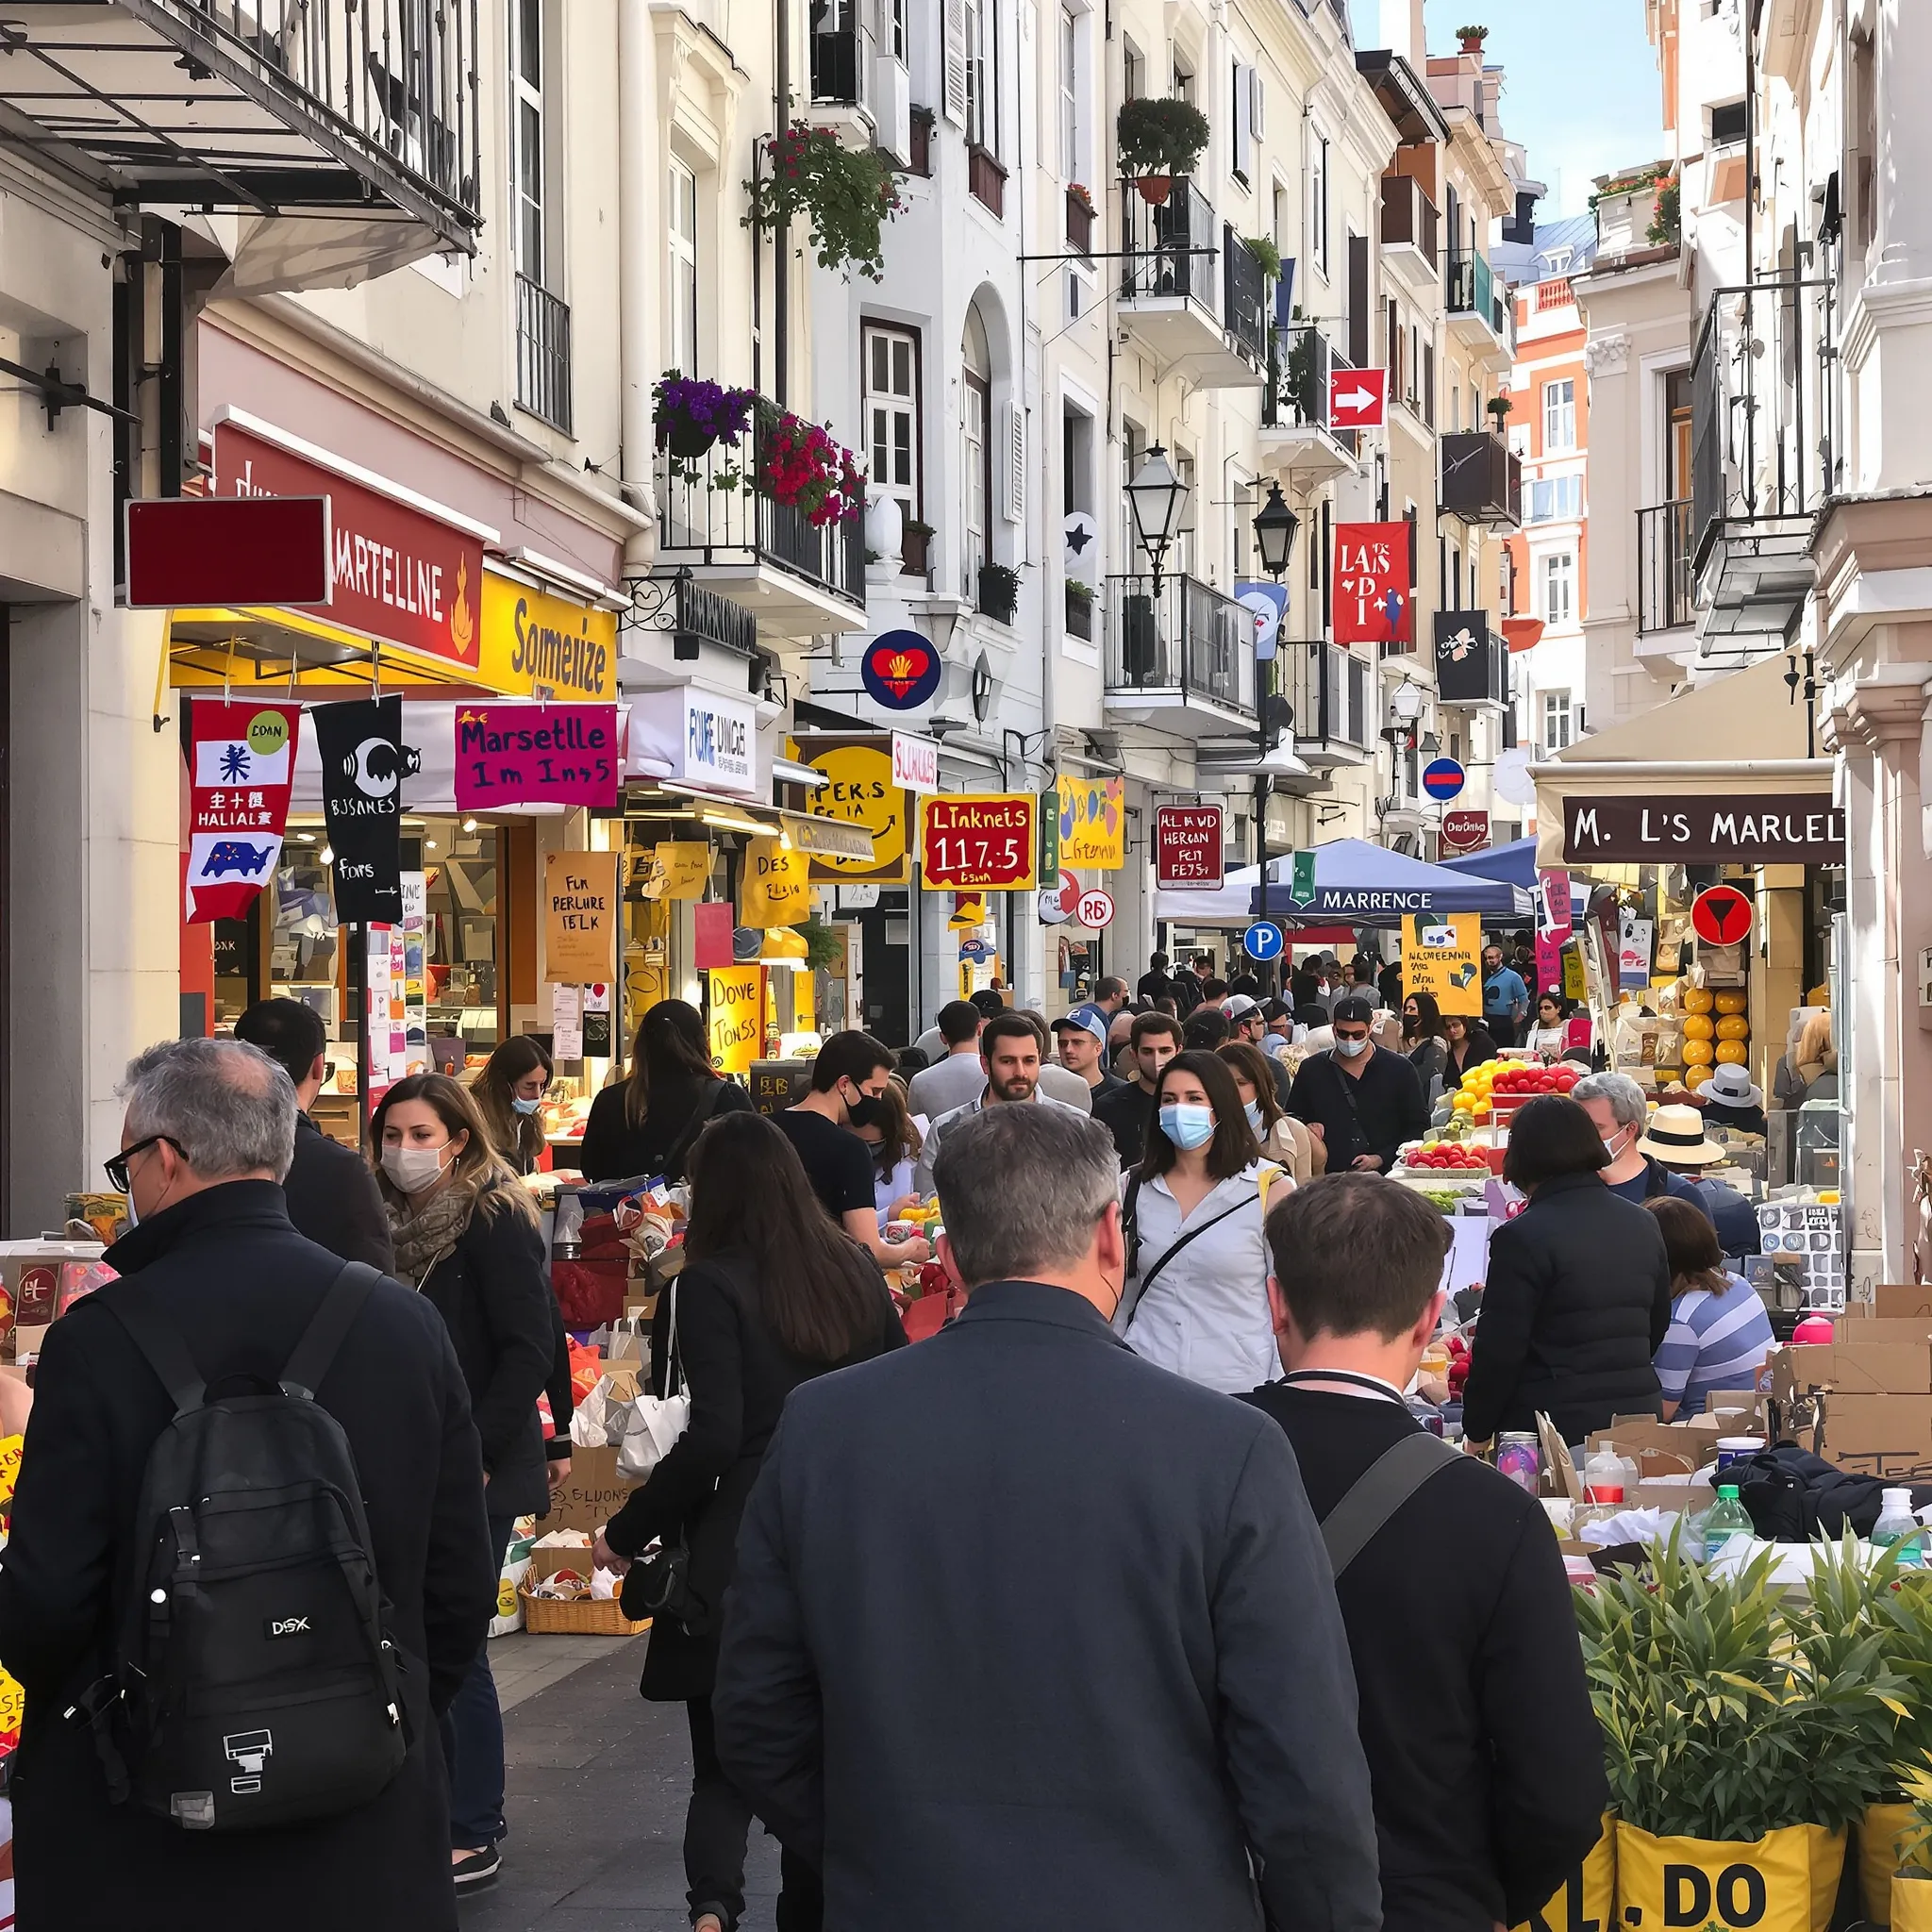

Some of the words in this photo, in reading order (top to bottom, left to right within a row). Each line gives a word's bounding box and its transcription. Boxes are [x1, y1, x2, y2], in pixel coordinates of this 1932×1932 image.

[1641, 808, 1691, 843] L'S
[1323, 891, 1432, 909] MARRENCE
[1255, 928, 1274, 954] P
[1662, 1863, 1767, 1928] DO
